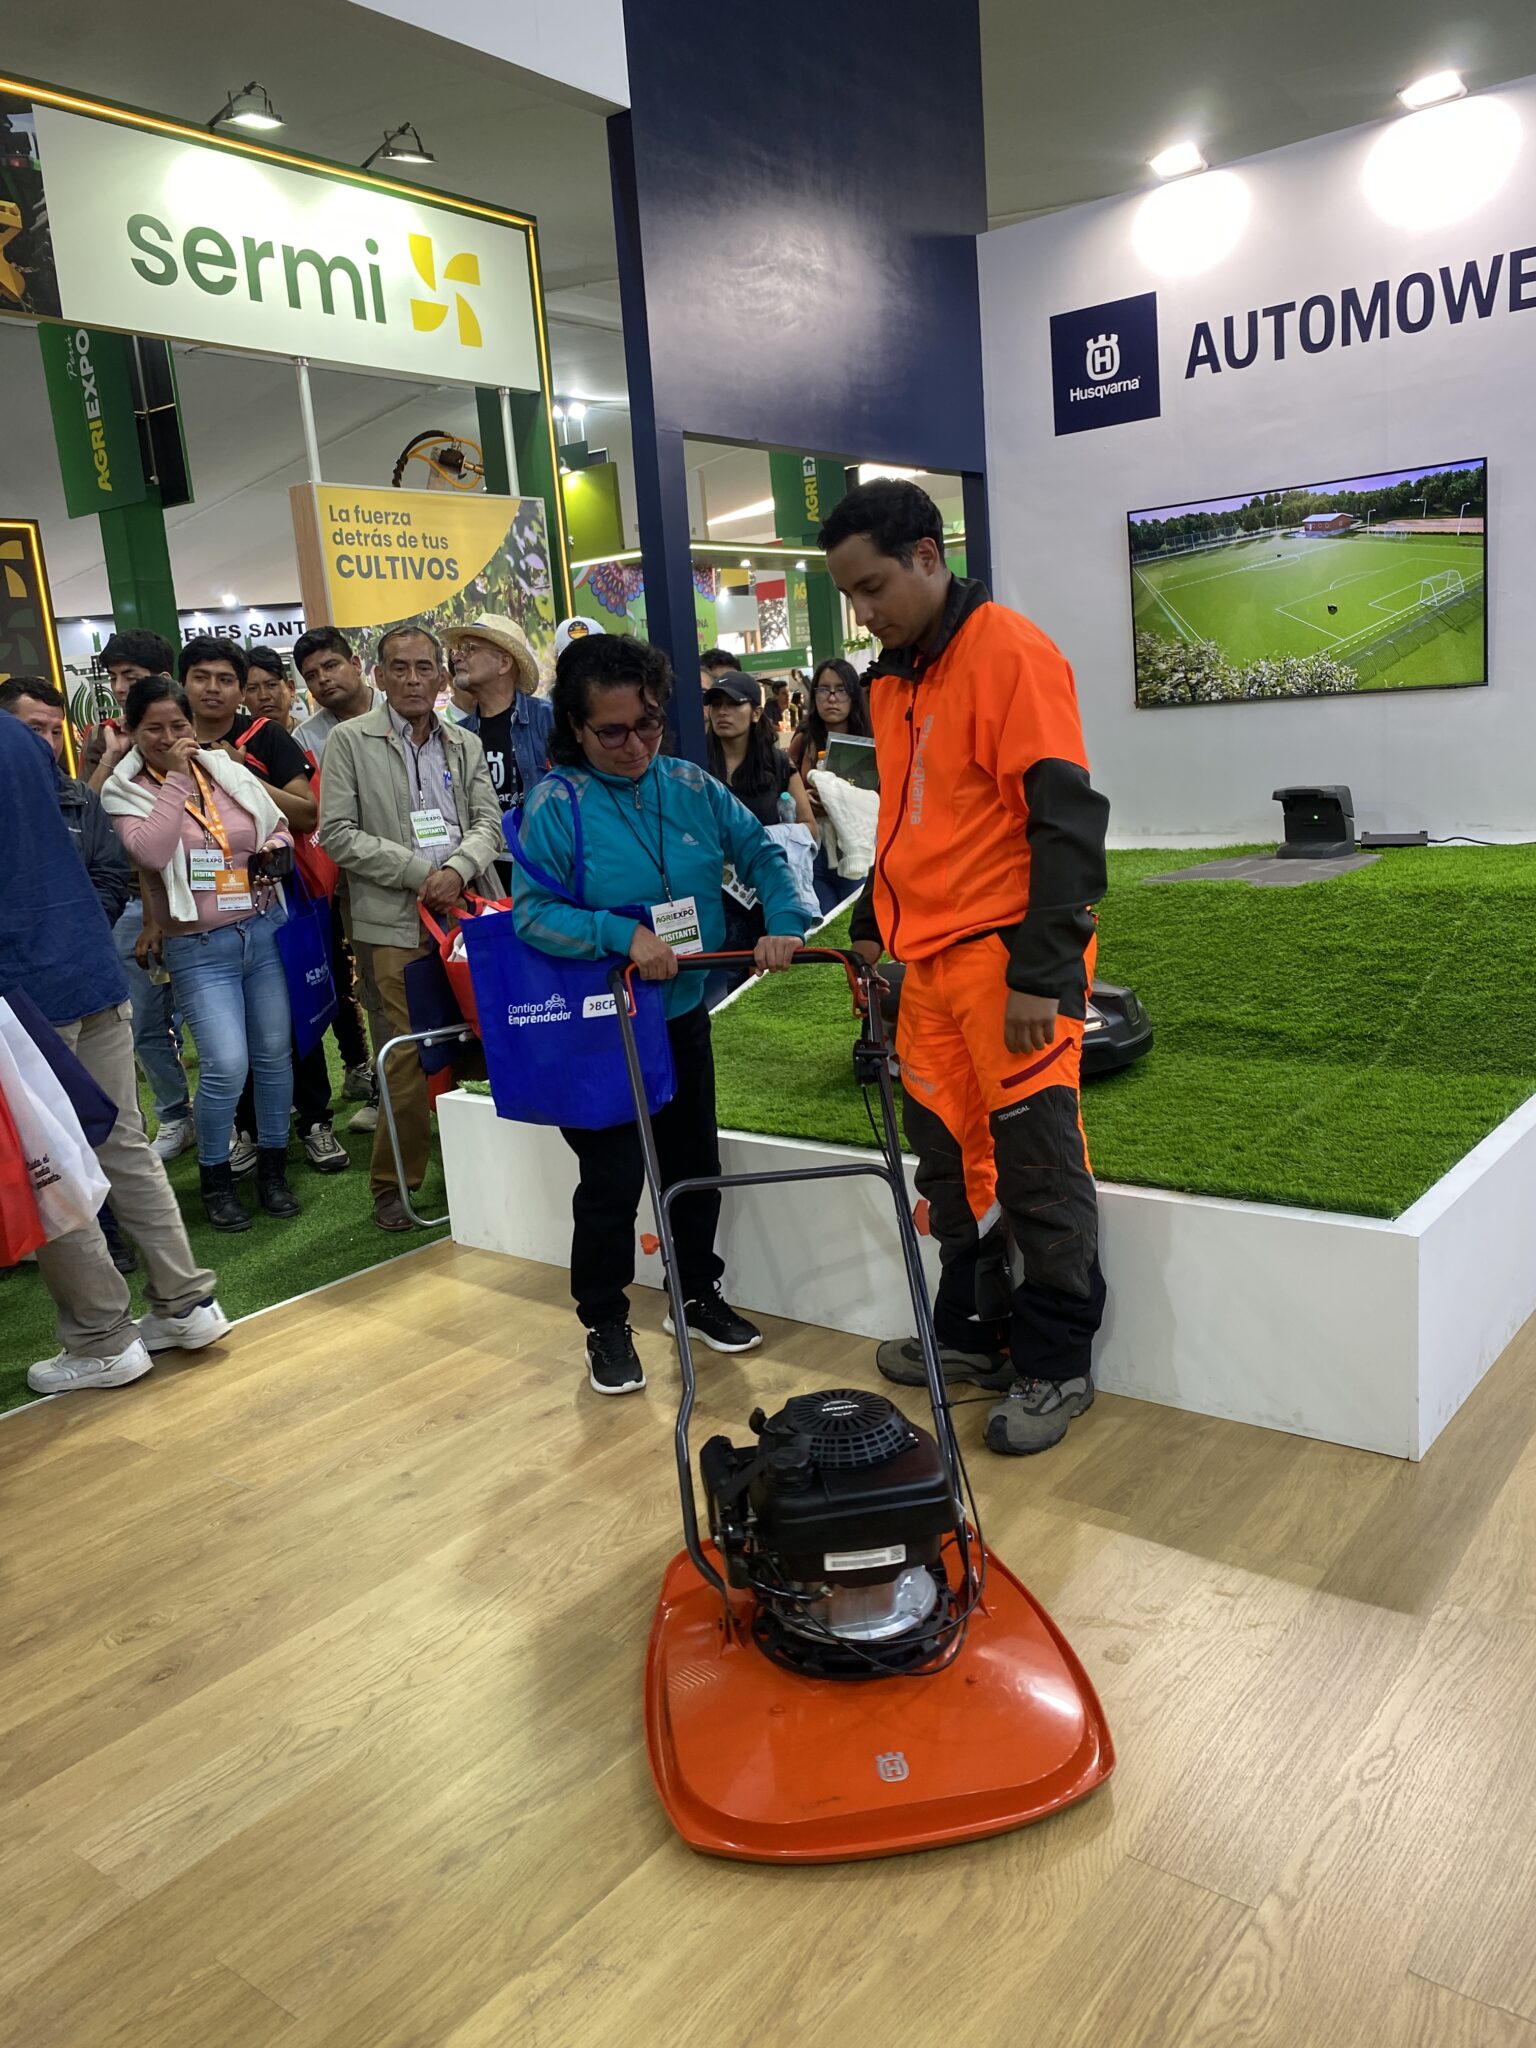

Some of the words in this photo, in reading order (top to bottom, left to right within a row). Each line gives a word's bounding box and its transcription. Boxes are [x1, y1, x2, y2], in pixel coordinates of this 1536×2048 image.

[126, 212, 388, 325] sermi
[1184, 247, 1536, 380] AUTOMOWE
[1069, 377, 1141, 402] Husqvarna
[75, 328, 113, 492] AGRIEXPO
[329, 504, 350, 522] La
[353, 504, 412, 526] fuerza
[332, 528, 392, 548] detrás
[396, 531, 418, 548] de
[421, 532, 449, 550] tus
[336, 554, 460, 581] CULTIVOS
[656, 908, 695, 925] AGRIEXPO
[660, 926, 697, 943] VISITANTE
[508, 1002, 544, 1014] Contigo
[595, 1000, 616, 1011] BCP
[508, 1010, 572, 1027] Emprendedor
